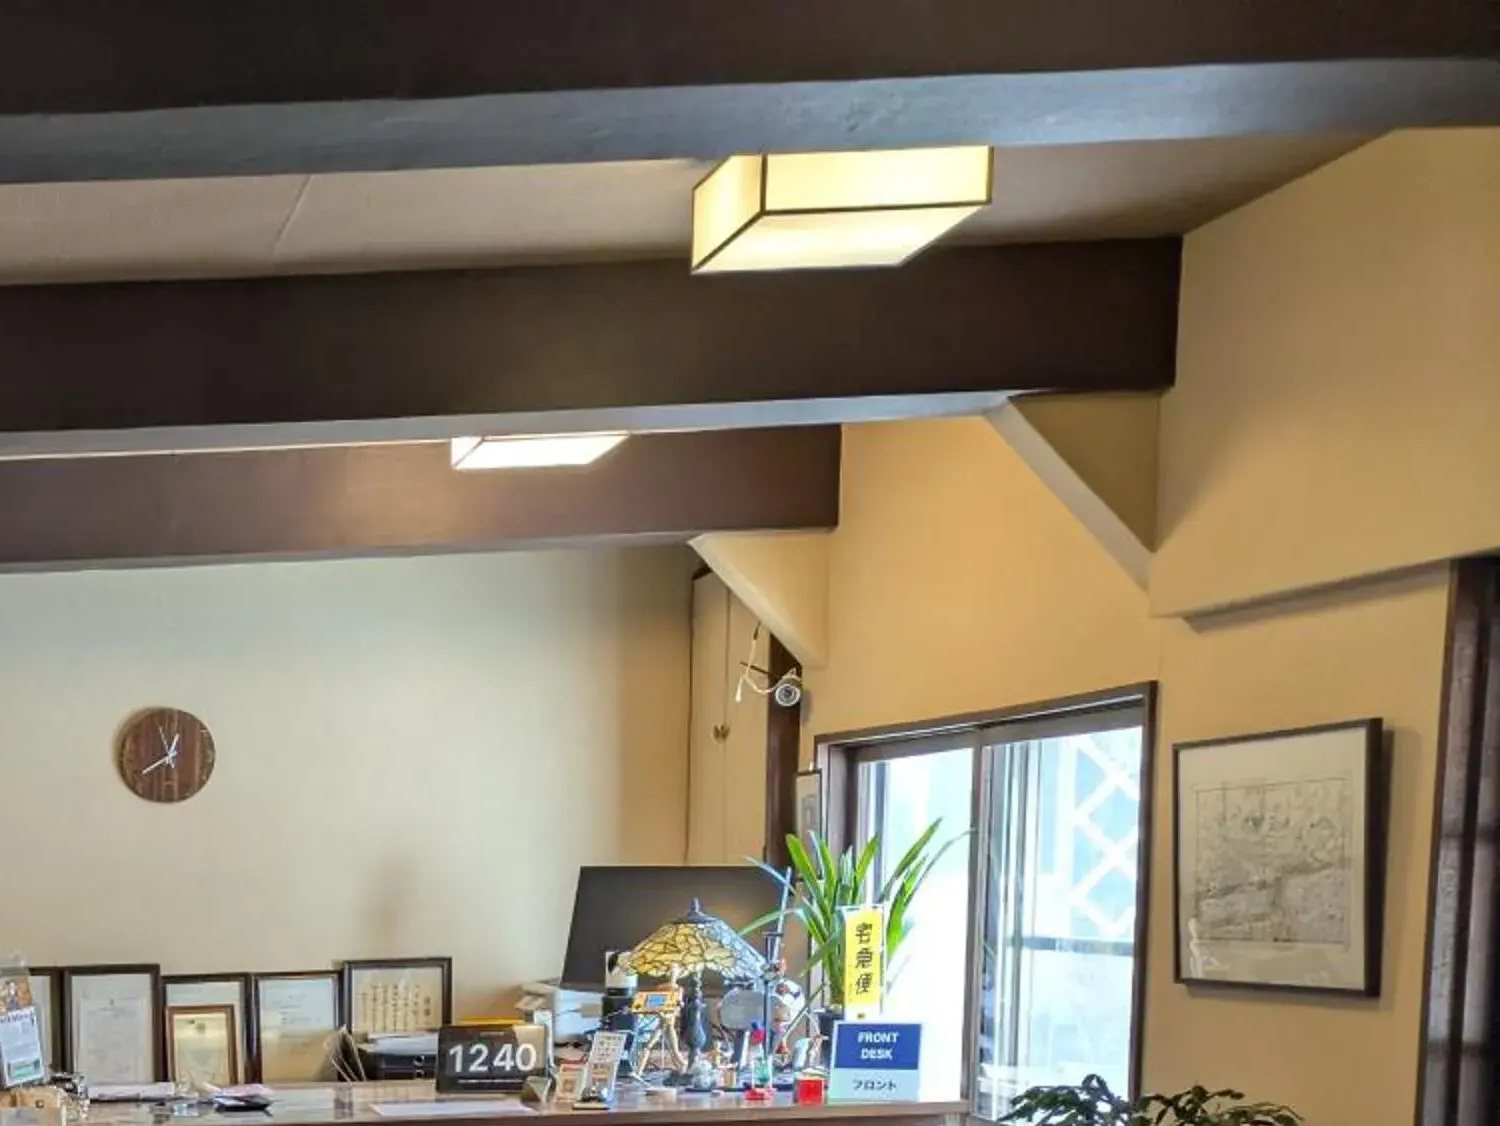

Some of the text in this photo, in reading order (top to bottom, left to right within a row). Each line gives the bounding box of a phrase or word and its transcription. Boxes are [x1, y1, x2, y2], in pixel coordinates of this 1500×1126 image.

[854, 921, 874, 996] 宅急便
[857, 1031, 900, 1044] FRONT
[860, 1048, 893, 1060] DESK
[852, 1079, 897, 1091] フロント
